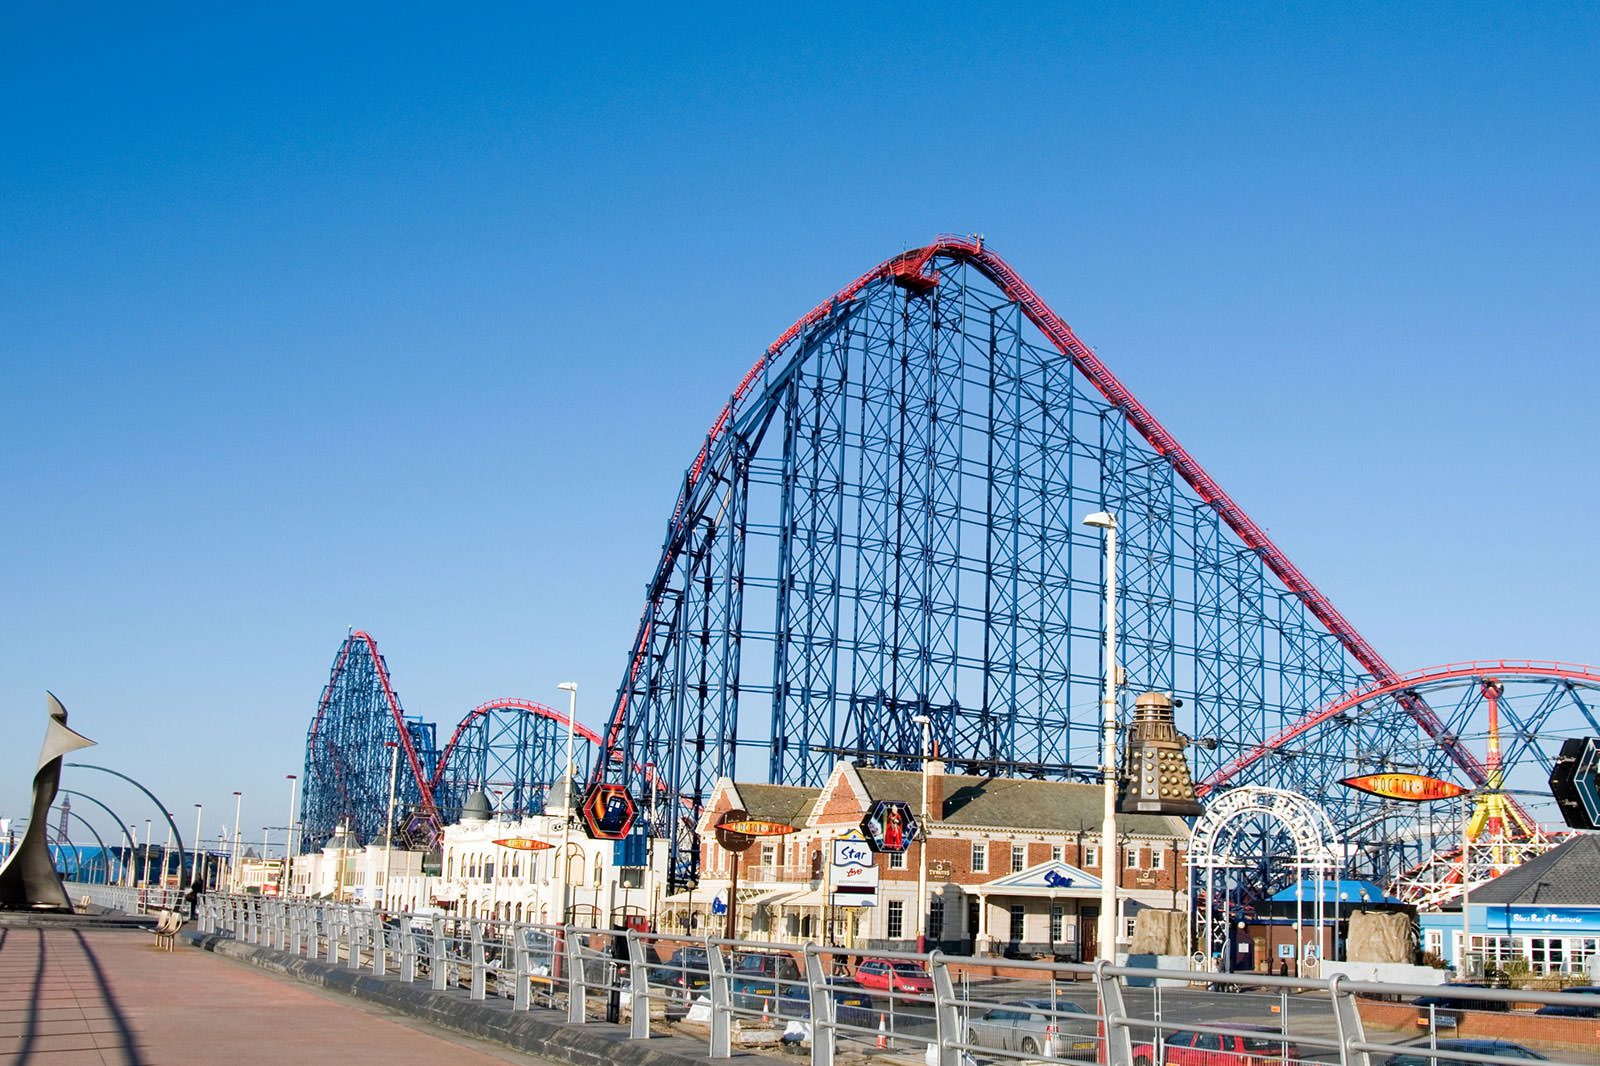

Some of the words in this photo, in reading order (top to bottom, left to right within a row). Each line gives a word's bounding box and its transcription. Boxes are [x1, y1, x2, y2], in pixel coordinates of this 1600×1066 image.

[1373, 777, 1414, 794] DOCTOR
[1422, 780, 1447, 796] WHO
[1272, 796, 1318, 854] BEACH
[841, 846, 867, 860] Star
